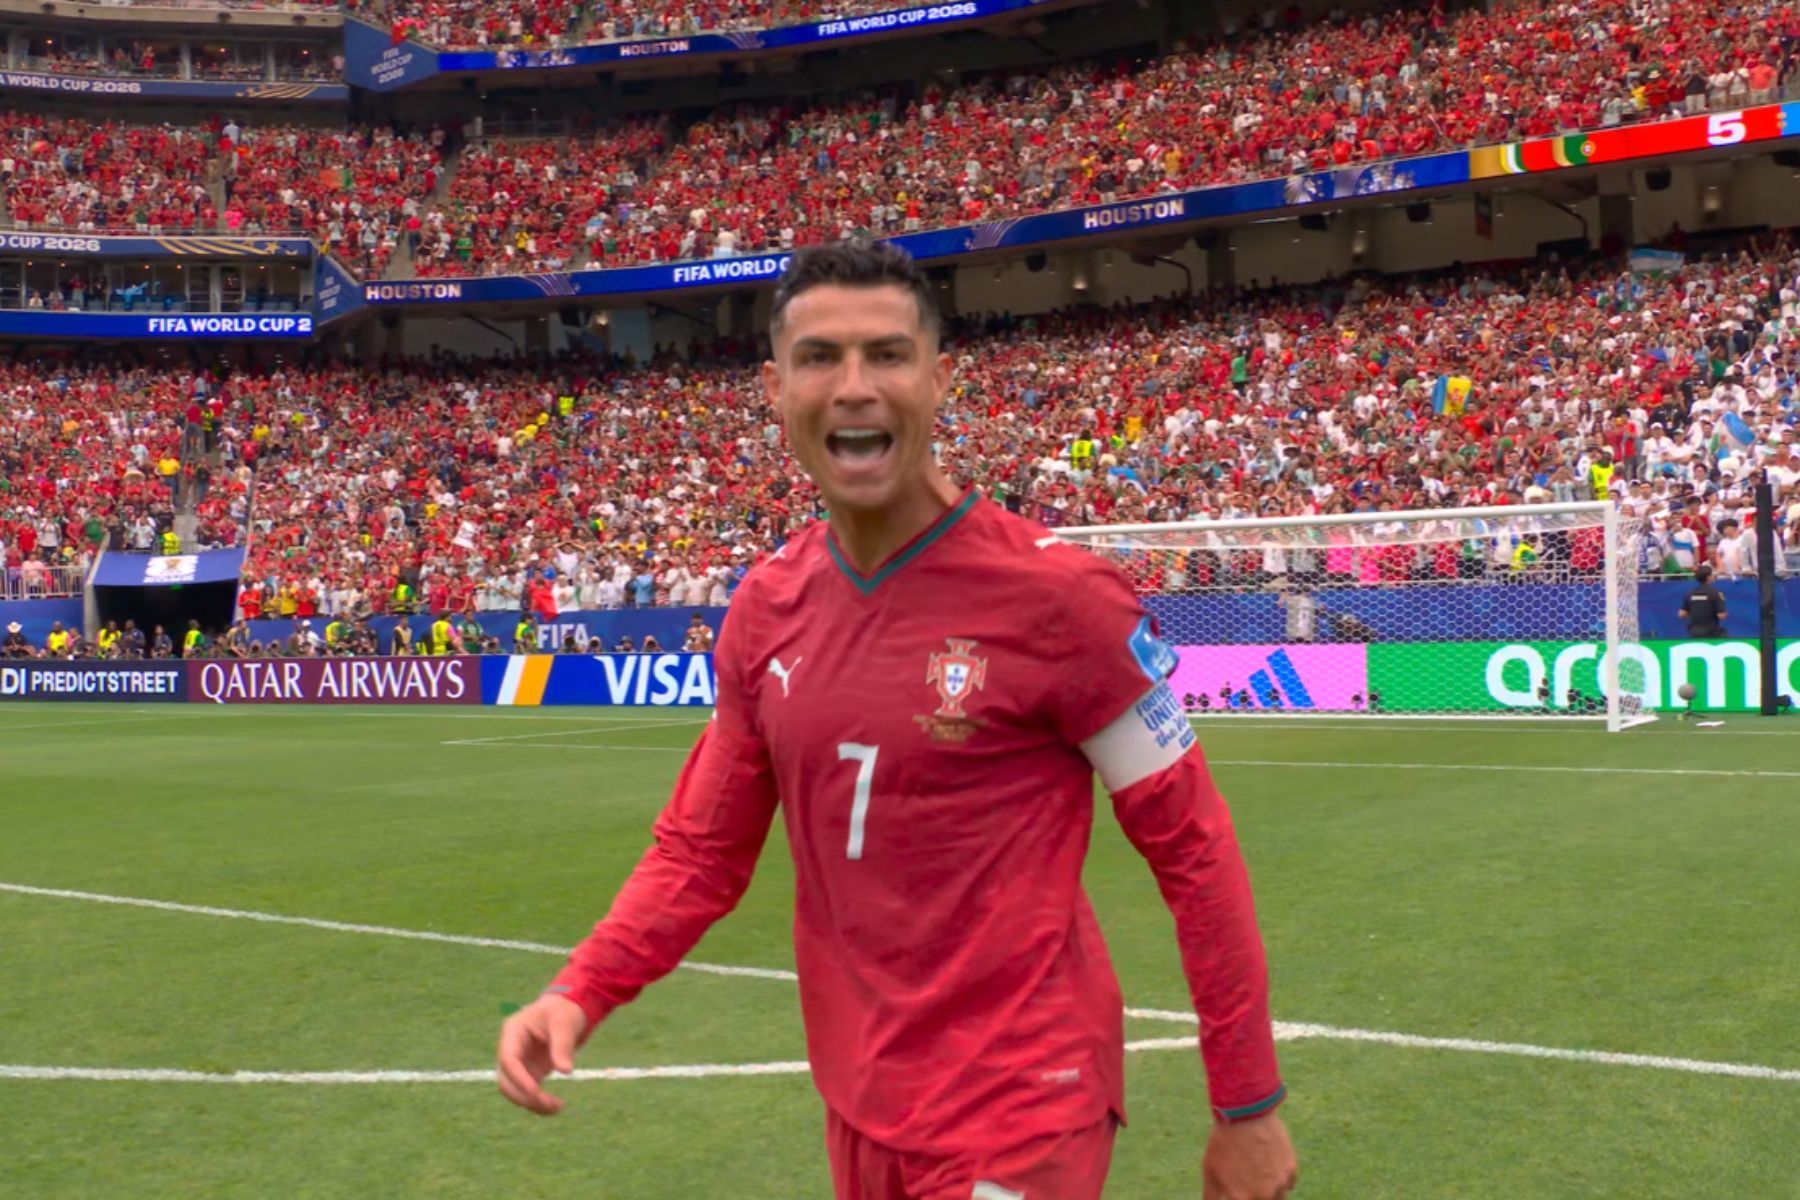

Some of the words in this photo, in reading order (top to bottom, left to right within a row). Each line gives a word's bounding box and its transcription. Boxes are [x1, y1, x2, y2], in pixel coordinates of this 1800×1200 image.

[818, 22, 848, 37] FIFA
[849, 14, 897, 32] WORLD
[899, 9, 927, 24] CUP
[927, 2, 977, 19] 2026
[620, 39, 689, 57] HOUSTON
[7, 76, 59, 89] WORLD
[61, 79, 90, 91] CUP
[91, 81, 142, 94] 2026
[1707, 110, 1747, 146] 5
[1083, 198, 1185, 229] HOUSTON
[9, 235, 42, 249] CUP
[43, 237, 100, 252] 2026
[673, 264, 711, 283] FIFA
[713, 258, 776, 279] WORLD
[365, 283, 462, 301] HOUSTON
[149, 317, 188, 333] FIFA
[189, 317, 257, 333] WORLD
[258, 317, 295, 333] CUP
[296, 318, 312, 332] 2
[537, 622, 589, 650] FIFA
[31, 670, 179, 694] PREDICTSTREET
[201, 662, 304, 704] QATAR
[316, 660, 466, 699] AIRWAYS
[593, 654, 715, 705] VISA
[837, 741, 880, 860] 7
